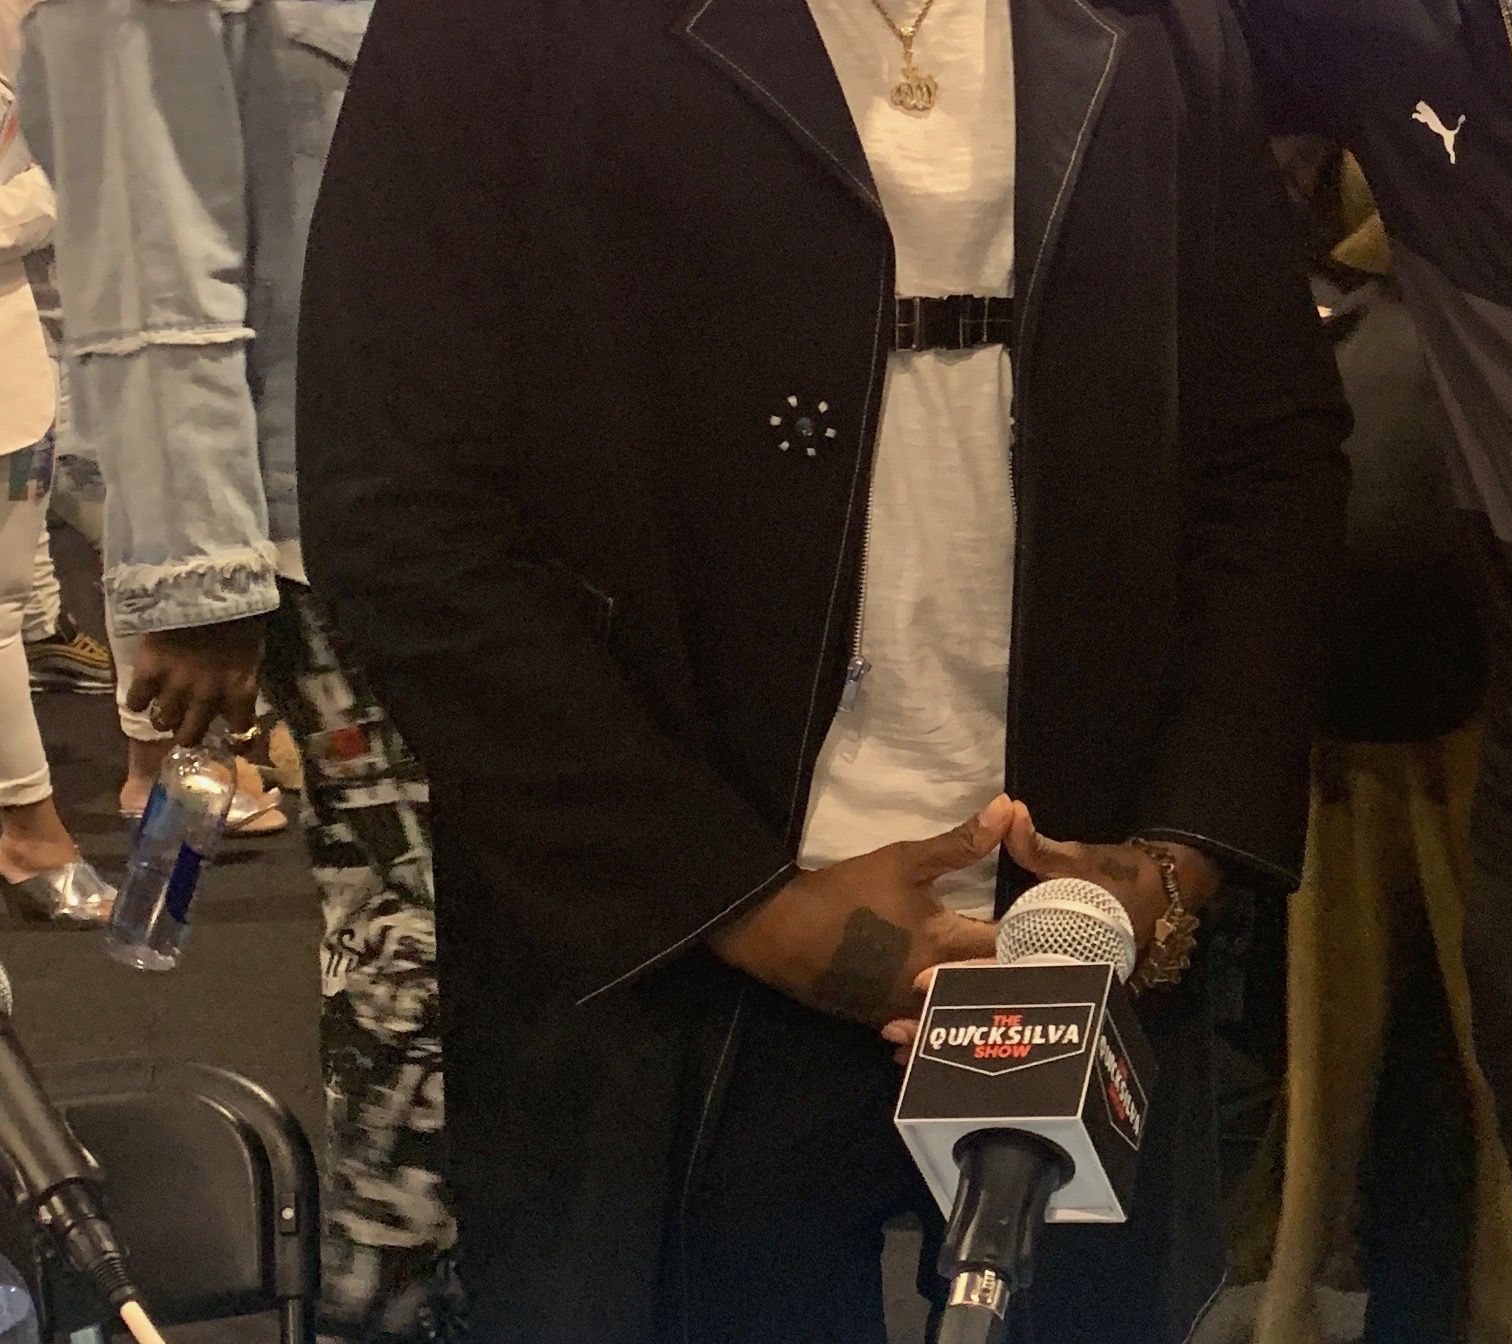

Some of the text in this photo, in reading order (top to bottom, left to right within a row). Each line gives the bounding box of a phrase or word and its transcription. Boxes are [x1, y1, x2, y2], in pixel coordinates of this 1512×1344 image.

[992, 1014, 1023, 1026] THE
[929, 1025, 1080, 1050] QUICKSILVA
[974, 1045, 1031, 1059] SHOW
